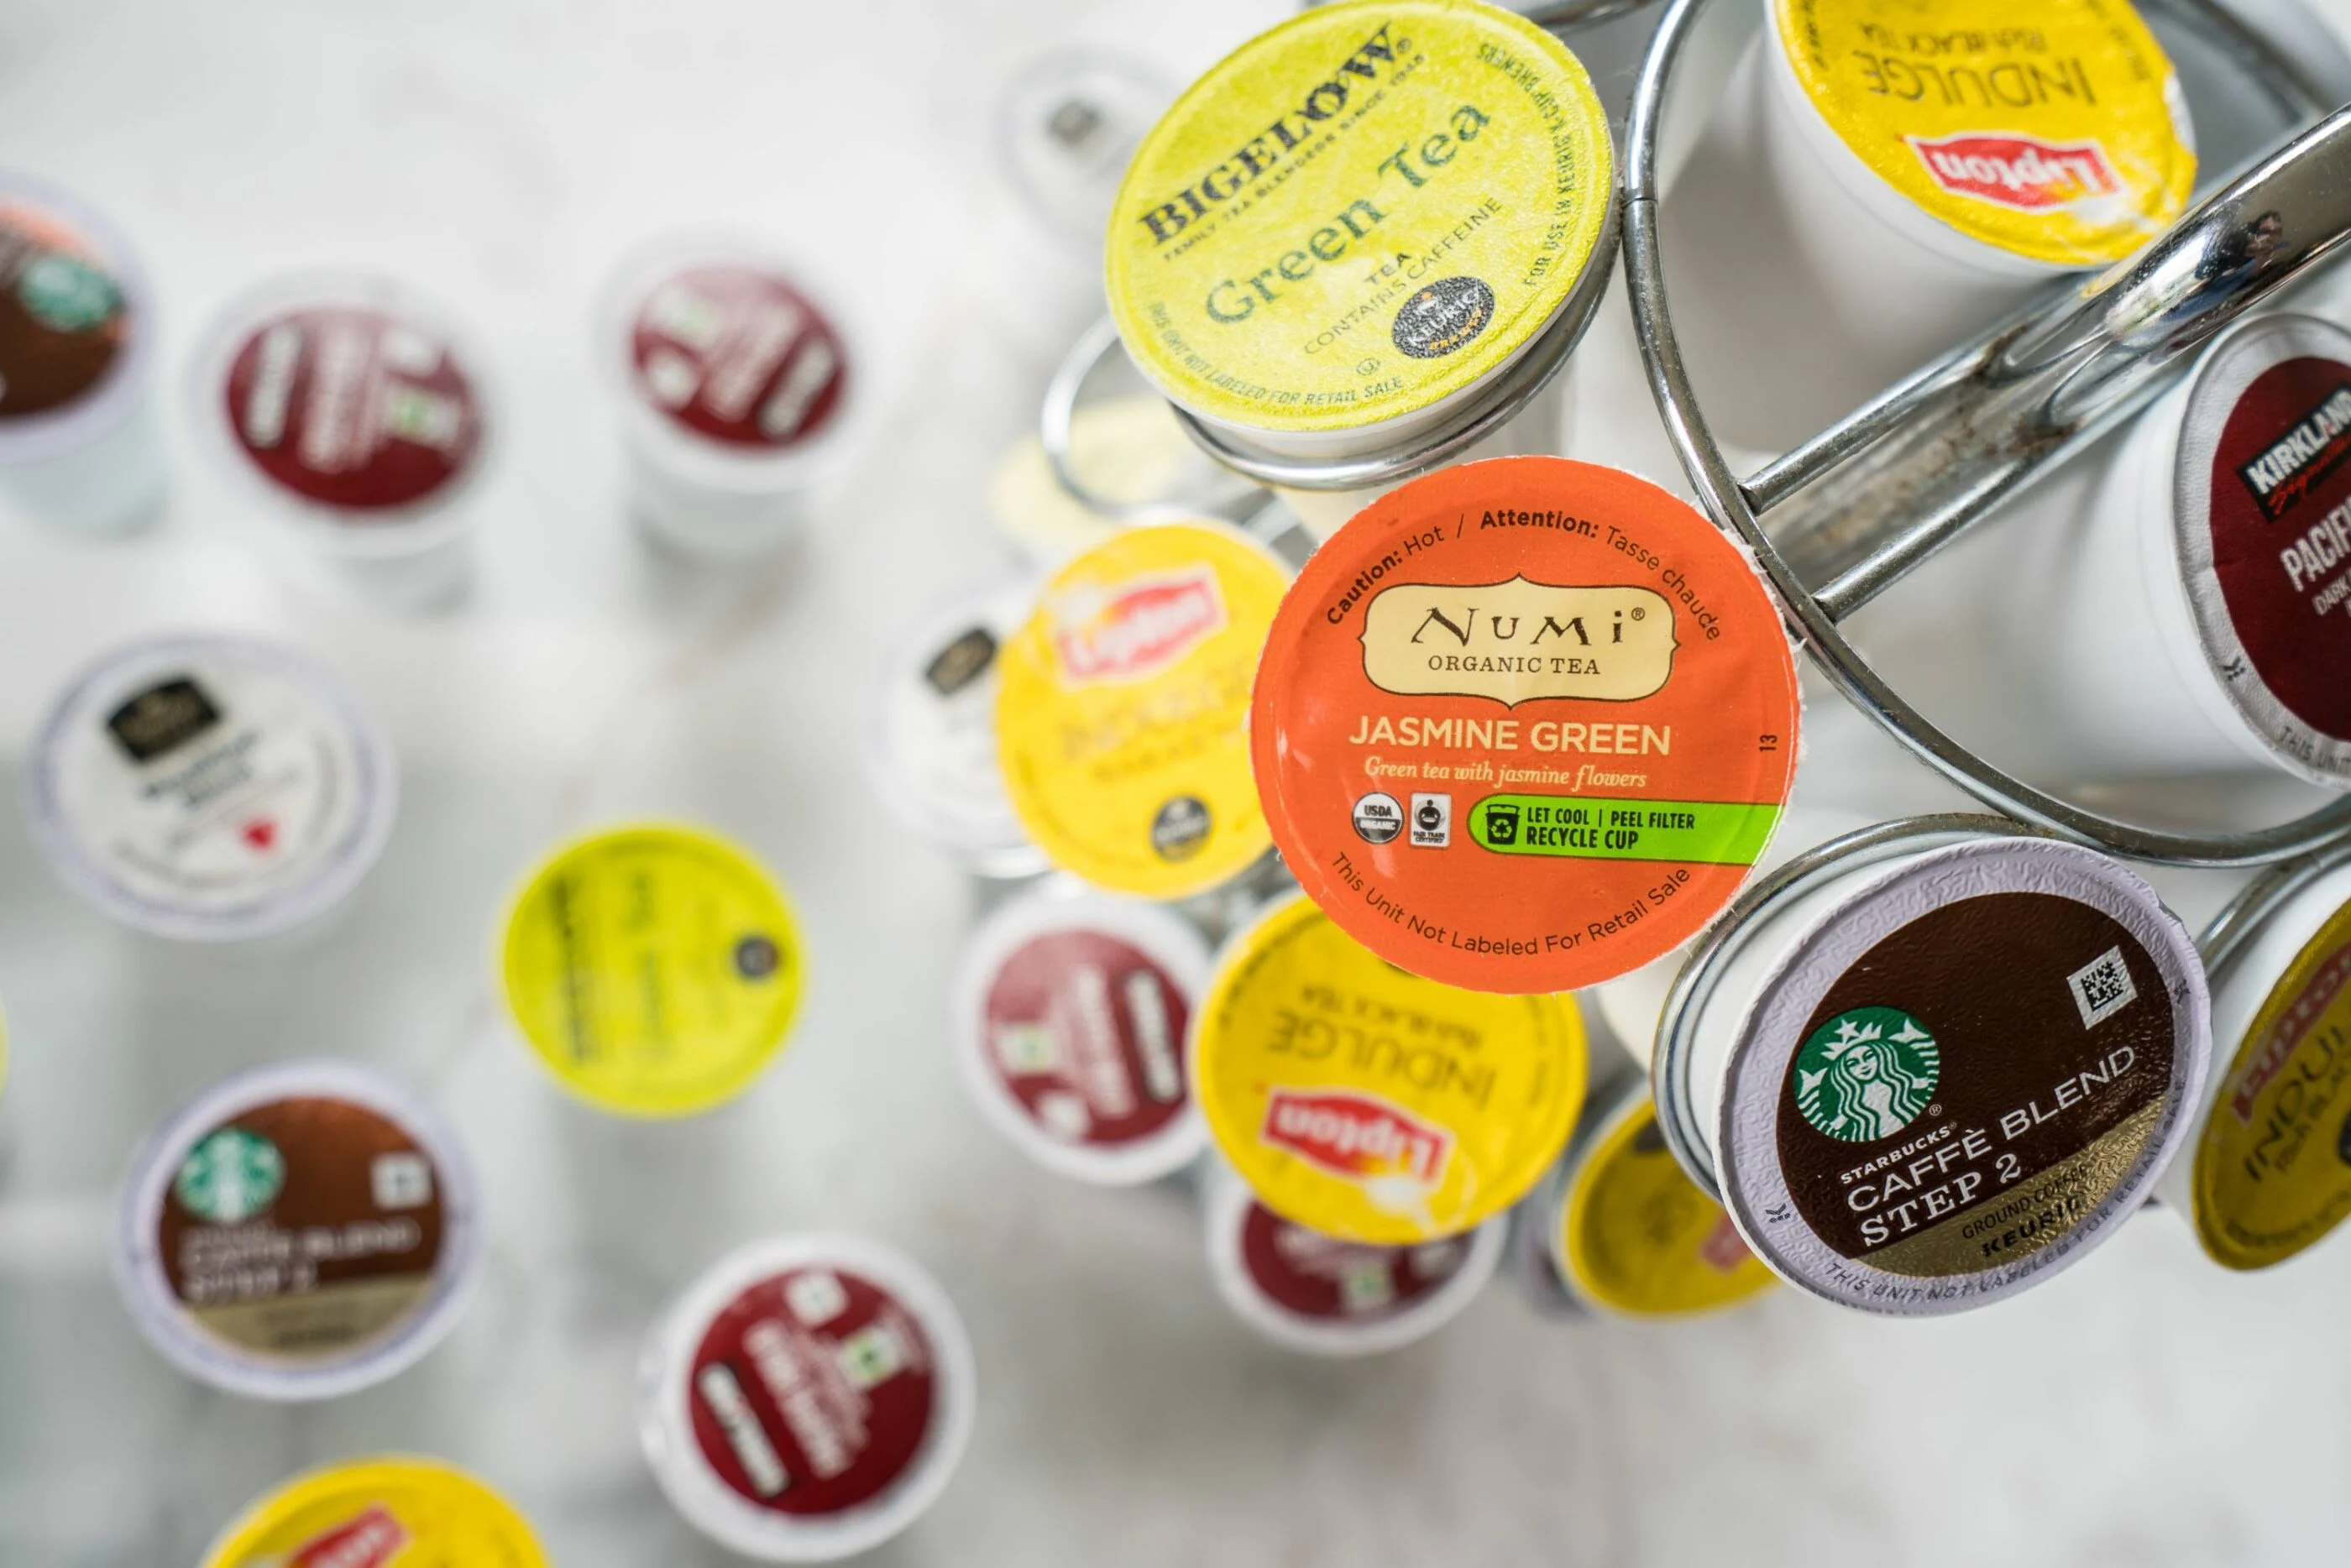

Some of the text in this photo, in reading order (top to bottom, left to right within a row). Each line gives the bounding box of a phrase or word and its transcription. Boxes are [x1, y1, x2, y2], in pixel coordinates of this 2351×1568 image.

[1476, 43, 1542, 93] BREWERS
[1851, 49, 2099, 109] INDULGE
[1222, 201, 1252, 223] TEA
[1256, 133, 1338, 197] BLENDERS
[1339, 91, 1386, 129] SINCE
[1552, 133, 1576, 198] KEURIG
[1931, 148, 2101, 195] Lipton
[1207, 104, 1491, 323] Green Tea
[1541, 222, 1569, 251] USE
[1556, 200, 1573, 217] IN
[1304, 197, 1504, 354] CONTAINS CAFFEINE
[1364, 252, 1412, 285] TEA
[1521, 253, 1552, 288] FOR
[1406, 285, 1479, 347] KEURIG
[1161, 330, 1189, 357] UNIT
[1183, 354, 1212, 379] NOT
[1207, 369, 1266, 400] LABELED
[1269, 389, 1302, 405] FOR
[1304, 389, 1359, 405] RETAIL
[1363, 375, 1405, 399] SALE
[1327, 550, 1405, 625] Caution:
[1403, 525, 1446, 557] Hot
[1479, 509, 1600, 539] Attention:
[1605, 525, 1661, 571] Tasse
[1662, 567, 1721, 641] chaude
[1428, 655, 1601, 675] ORGANIC TEA
[1348, 715, 1671, 755] JASMINE GREEN
[1759, 734, 1778, 753] 13
[1364, 755, 1647, 792] Green tea with jasmine flowers
[1360, 820, 1397, 831] ORGANIC
[1364, 804, 1394, 818] USDA
[1428, 831, 1446, 839] TRADE
[1526, 826, 1639, 850] RECYCLE CUP
[1527, 807, 1551, 824] LET
[1555, 808, 1589, 826] COOL
[1610, 811, 1643, 828] PEEL
[1648, 812, 1695, 830] FILTER
[1331, 851, 1691, 956] This Unit Not Labeled For Retail Sale
[1265, 1008, 1498, 1110] INDULGE
[1276, 1104, 1434, 1178] Lipton
[1847, 1046, 2135, 1213] CAFFÈ BLEND
[1825, 1262, 1866, 1292] THIS
[1872, 1283, 1928, 1303] UNIT
[1929, 1285, 1971, 1302] NOT
[1979, 1244, 2071, 1294] LABELED
[2076, 1206, 2114, 1243] FOR
[2114, 1139, 2166, 1204] RETAIL
[1860, 1152, 2022, 1248] STEP 2
[1961, 1163, 2089, 1240] GROUND COFFEE
[1982, 1194, 2084, 1258] KEURIG
